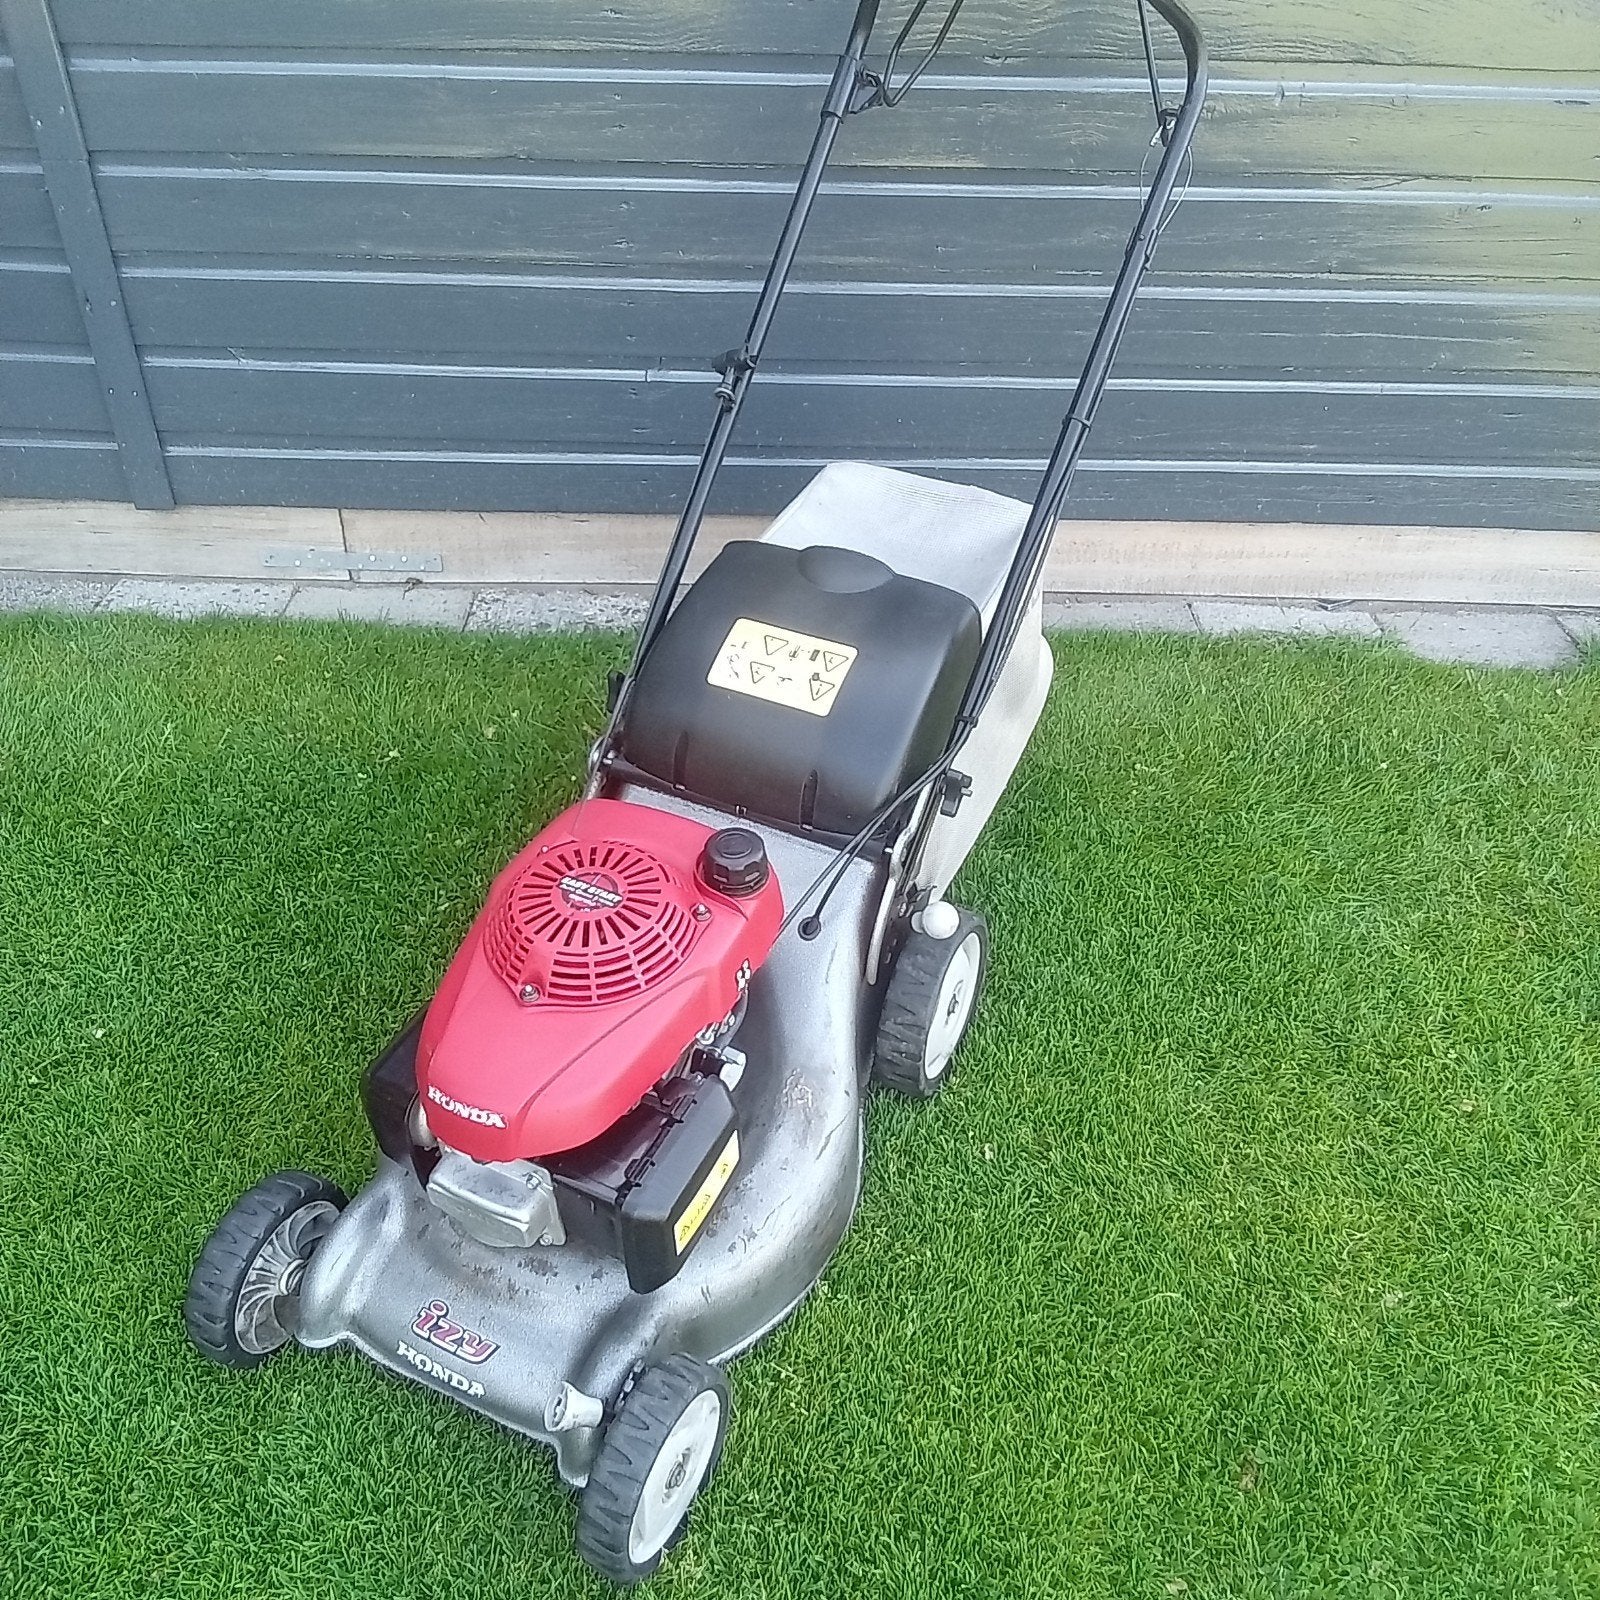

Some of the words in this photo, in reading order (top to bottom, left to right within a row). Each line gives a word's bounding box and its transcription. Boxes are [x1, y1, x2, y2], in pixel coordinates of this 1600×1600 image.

[427, 1084, 508, 1129] HONDA
[410, 1299, 501, 1365] izy
[396, 1339, 486, 1399] HONDA
